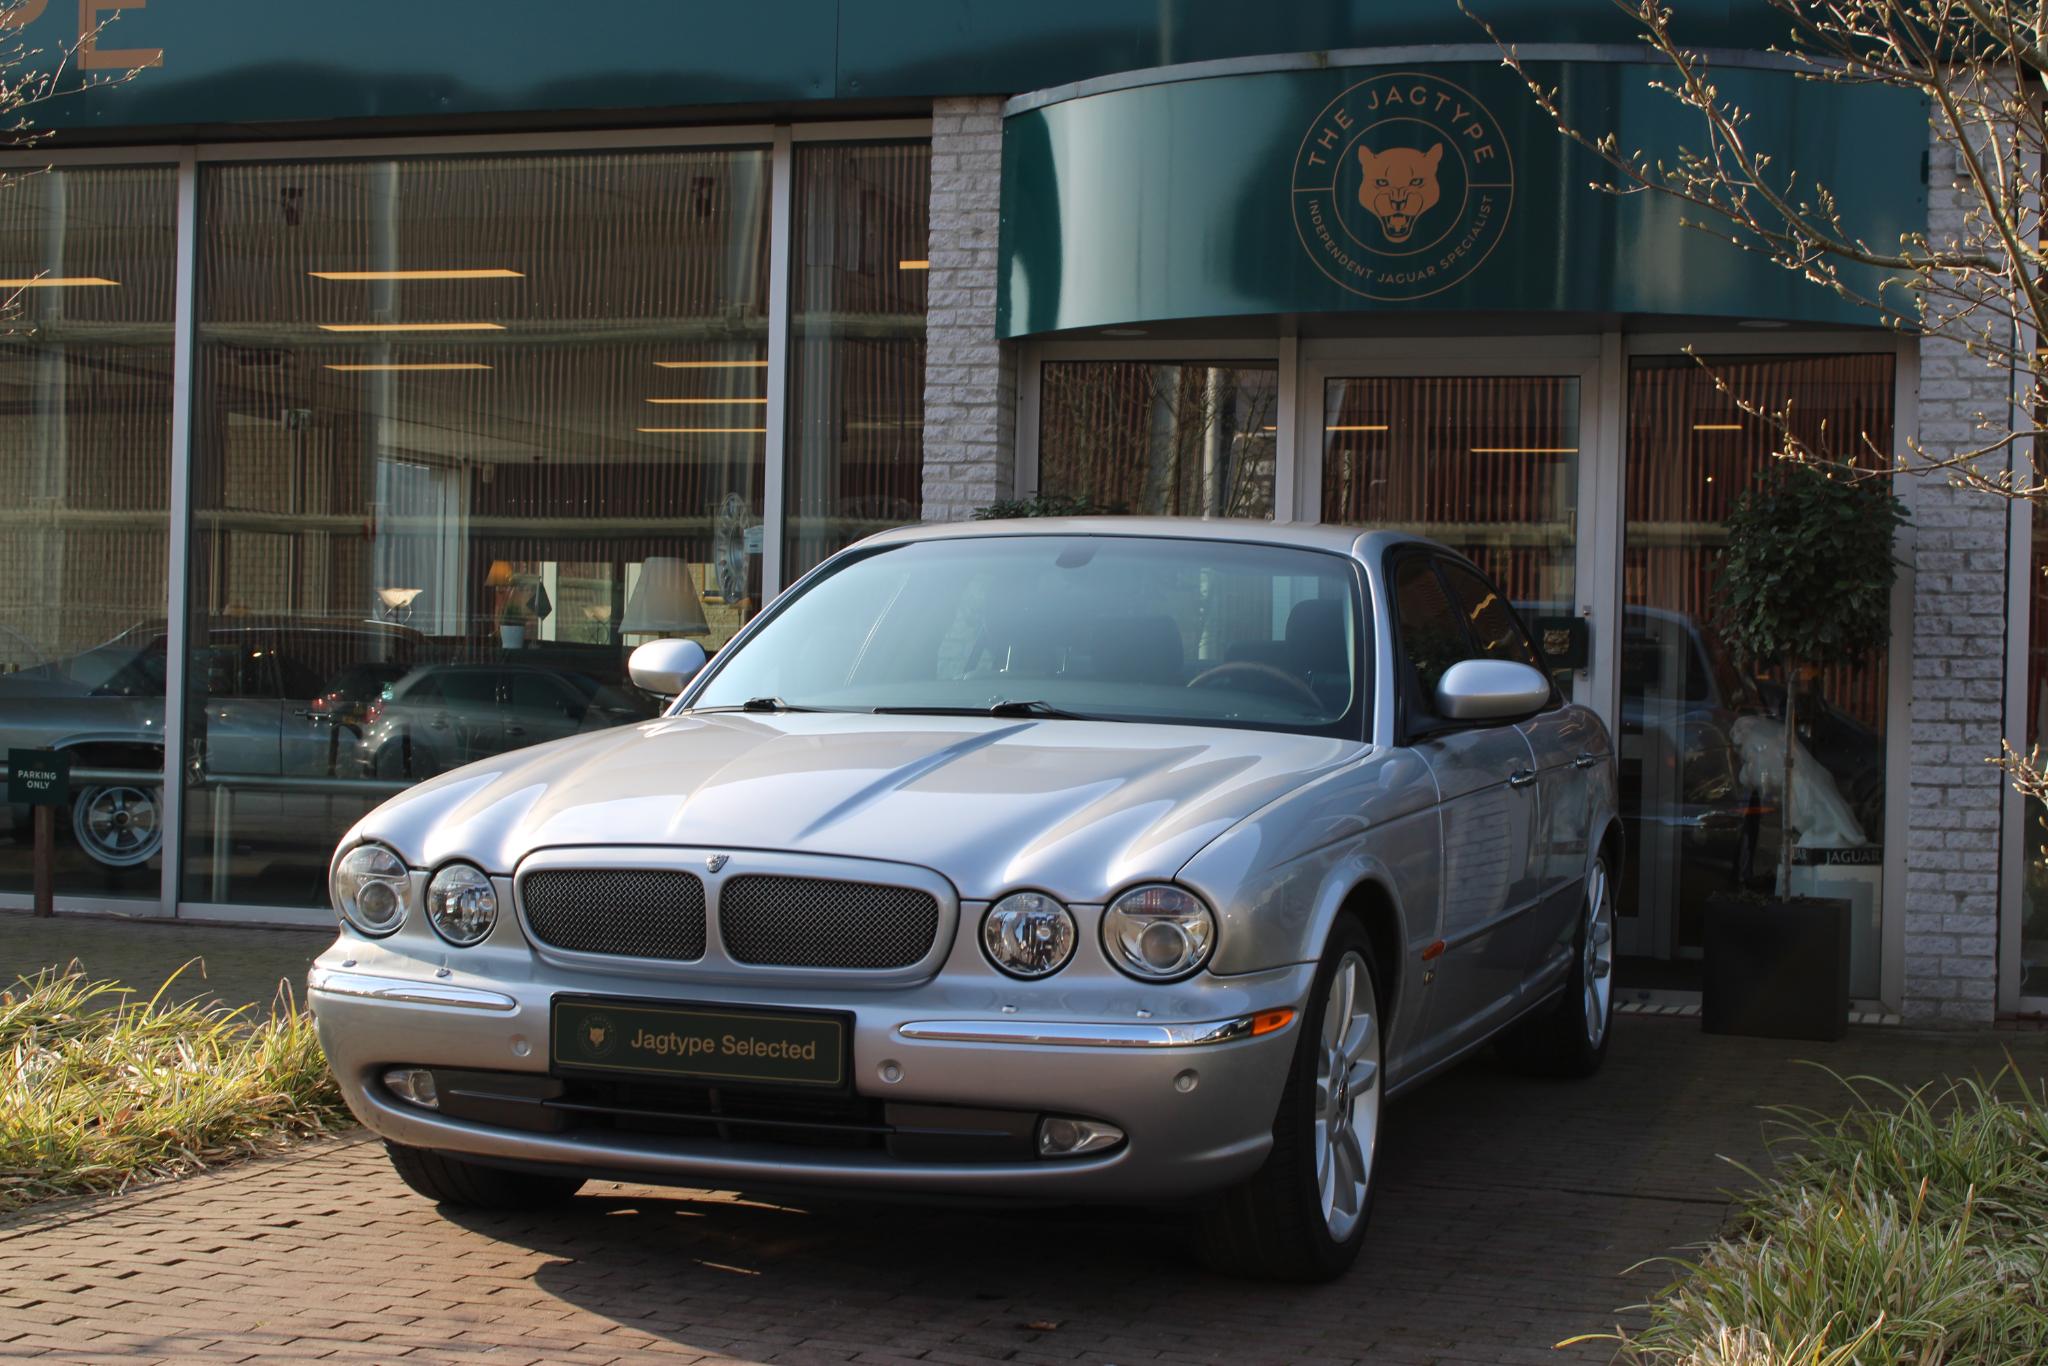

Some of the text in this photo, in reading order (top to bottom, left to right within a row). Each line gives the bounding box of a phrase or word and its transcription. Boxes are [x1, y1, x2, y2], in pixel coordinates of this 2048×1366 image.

[1308, 85, 1494, 167] THE JAGTYPE
[1308, 193, 1494, 284] INDEPENDENT JAGUAR SPECIALIST
[17, 770, 57, 780] PARKING
[27, 781, 50, 789] ONLY
[1826, 849, 1880, 865] JAGUAR
[630, 1028, 715, 1056] Jagtype
[721, 1034, 817, 1060] Selected
